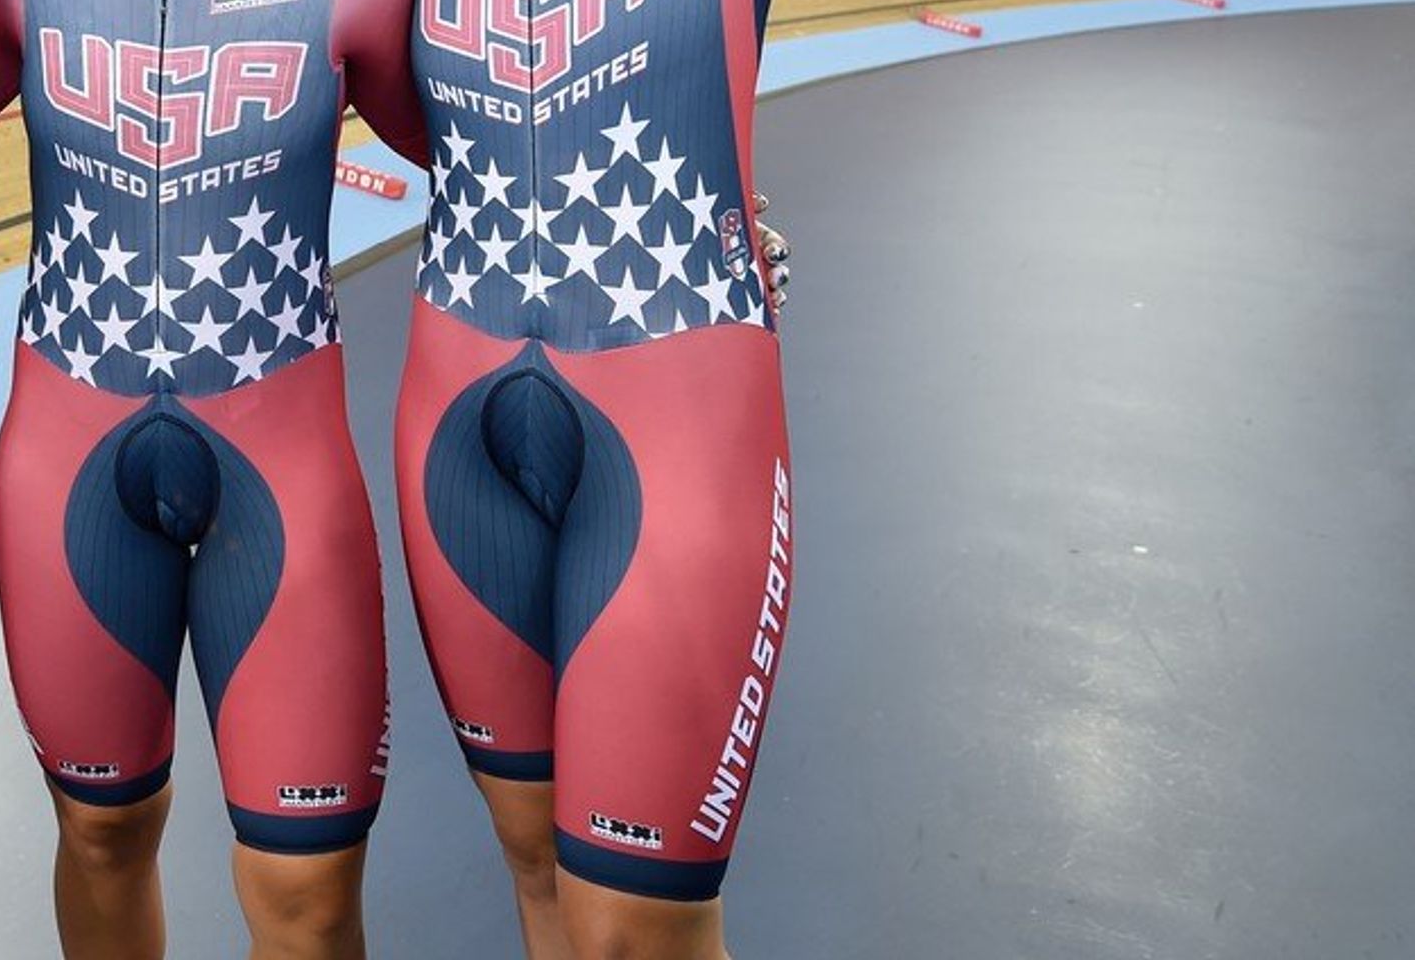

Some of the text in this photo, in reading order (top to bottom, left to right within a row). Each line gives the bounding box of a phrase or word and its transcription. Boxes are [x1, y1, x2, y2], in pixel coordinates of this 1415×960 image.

[40, 27, 308, 170] USA
[428, 41, 650, 126] UNITED STATES
[54, 143, 282, 204] UNITED STATES
[690, 456, 791, 843] UNITED STATES
